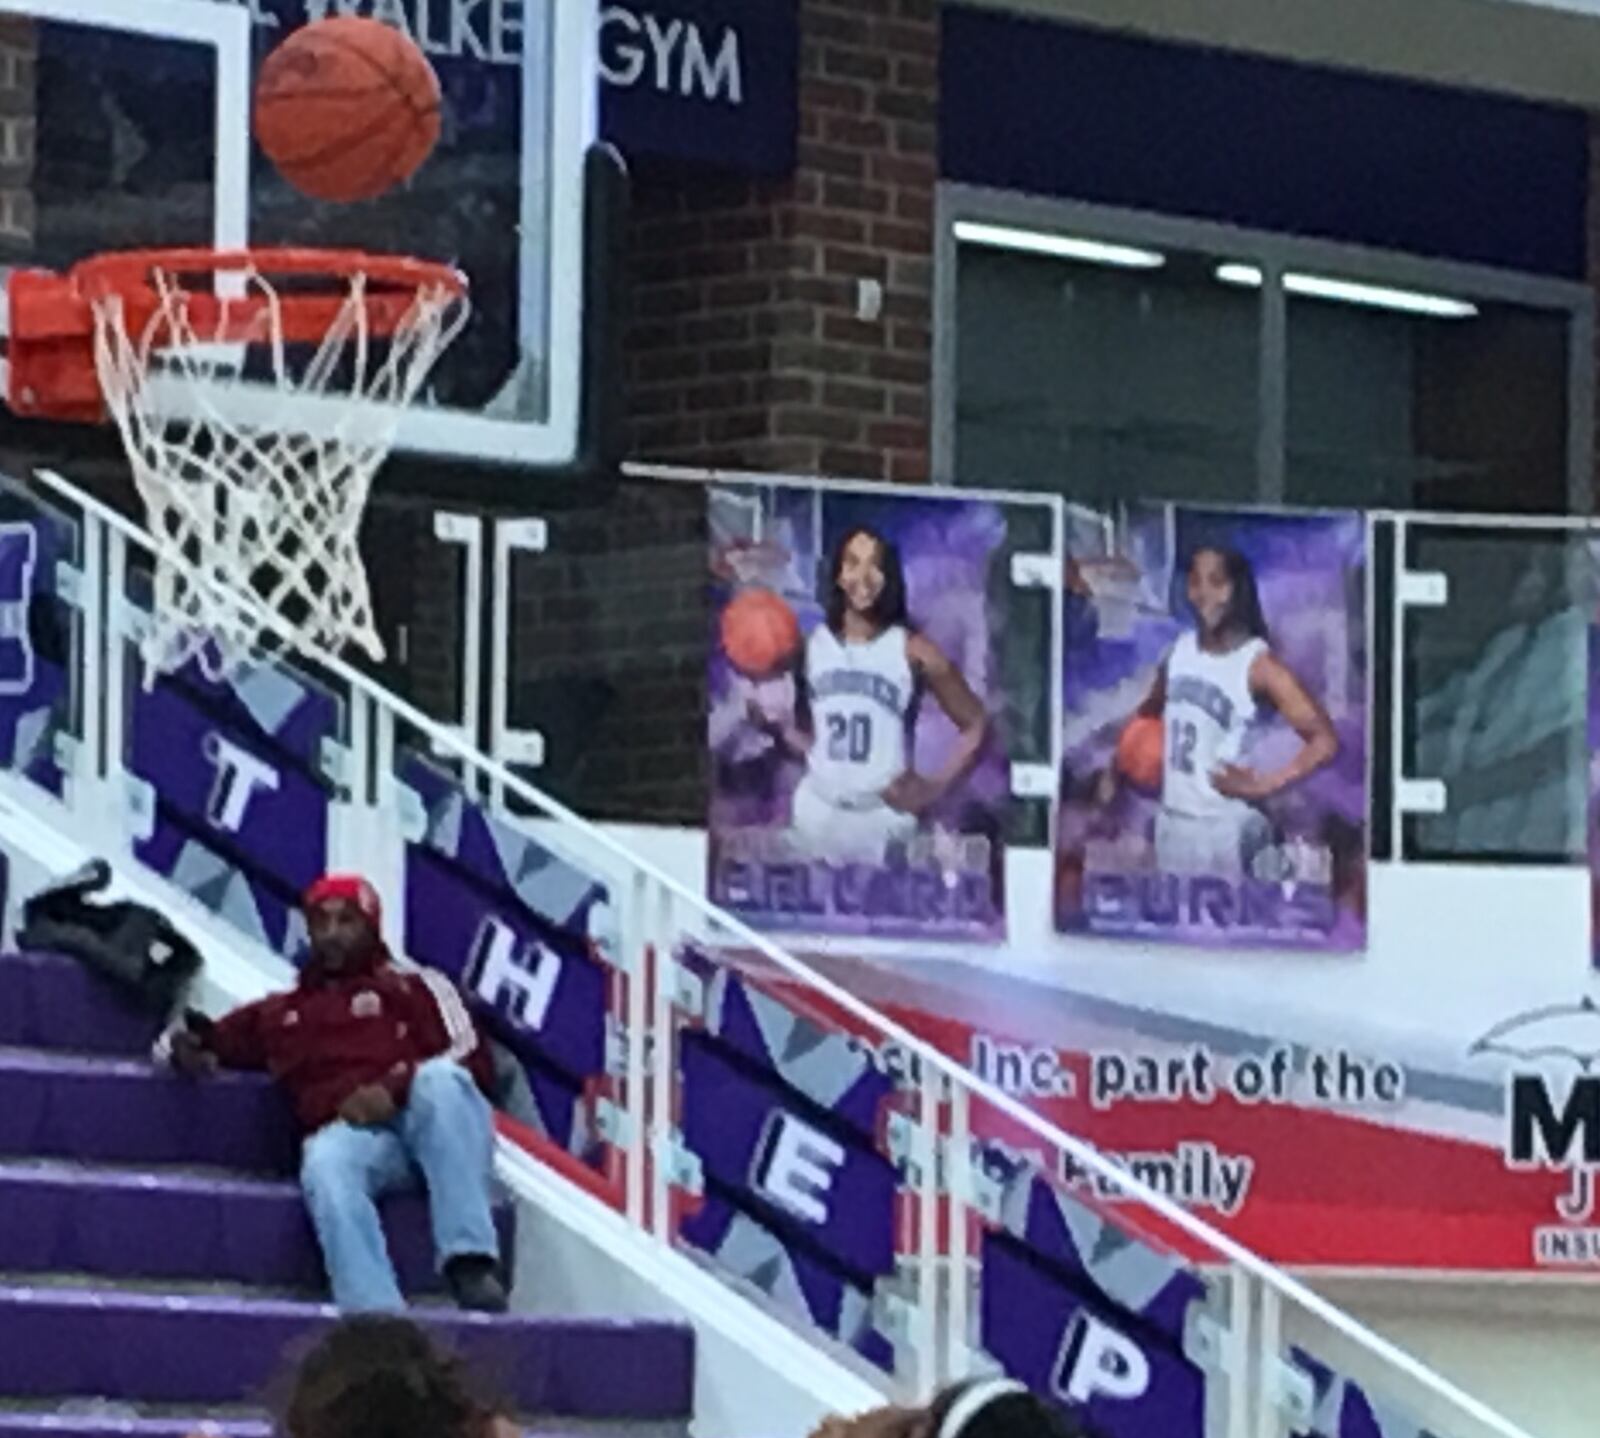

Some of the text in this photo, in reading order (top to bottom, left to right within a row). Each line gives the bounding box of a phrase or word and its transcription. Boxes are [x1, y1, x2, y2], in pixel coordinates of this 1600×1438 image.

[599, 6, 742, 102] GYM
[206, 731, 279, 832] T
[825, 712, 871, 764] 20
[463, 915, 562, 1032] H
[976, 1040, 1071, 1089] Inc.
[1097, 1051, 1210, 1102] part
[1234, 1050, 1288, 1096] of
[1312, 1052, 1400, 1101] the
[750, 1108, 845, 1225] E
[1051, 1308, 1150, 1402] P
